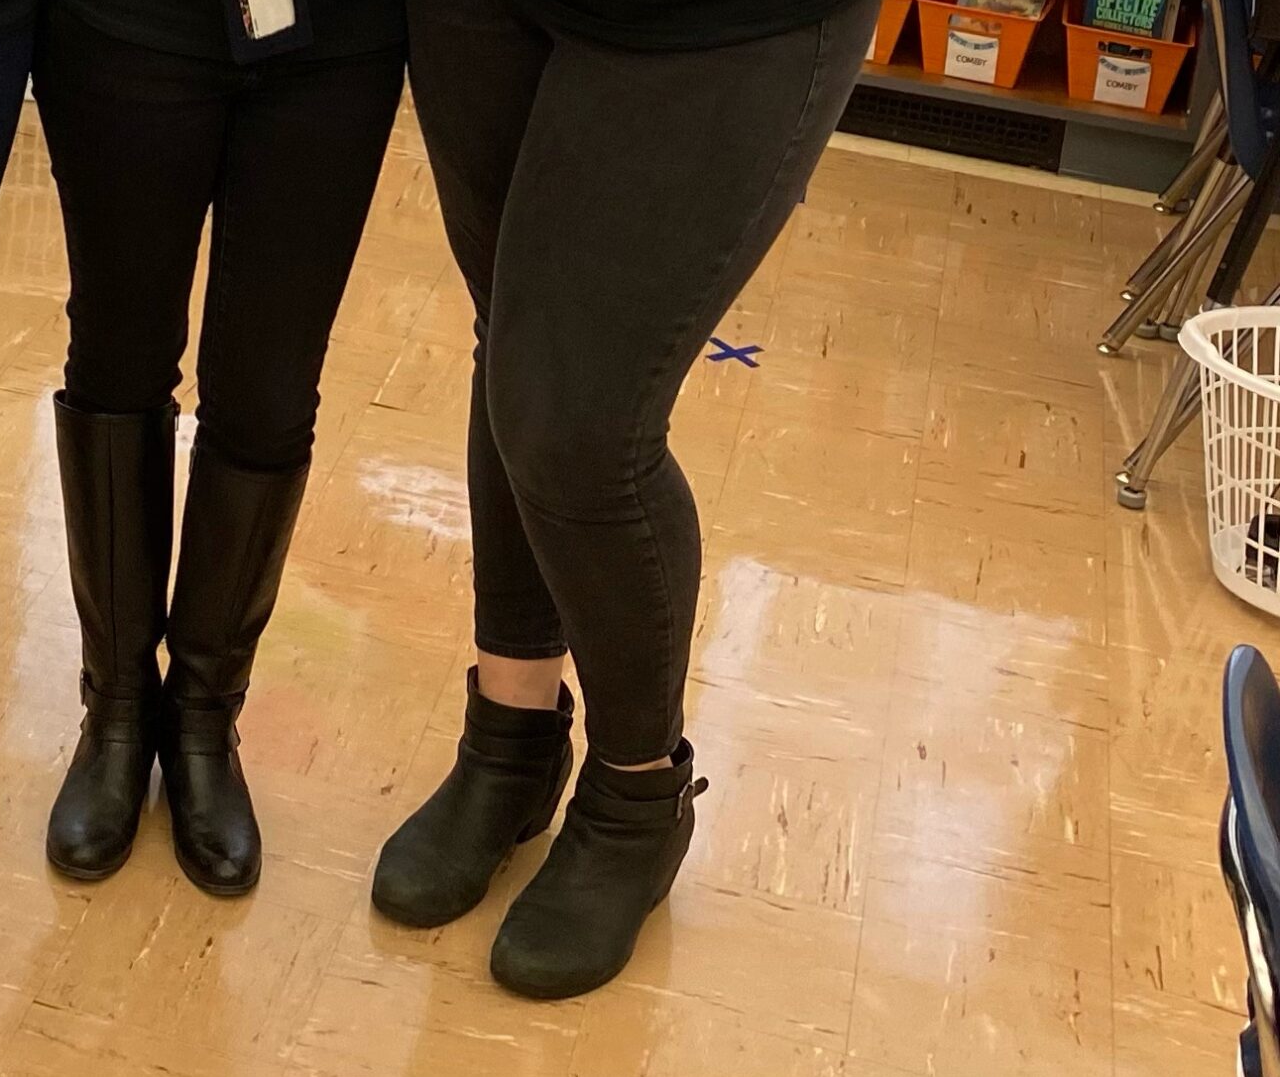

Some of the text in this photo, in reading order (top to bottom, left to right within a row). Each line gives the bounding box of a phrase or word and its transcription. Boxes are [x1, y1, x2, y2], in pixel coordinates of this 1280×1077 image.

[1096, 7, 1156, 30] COLLECTORS
[956, 54, 987, 66] COMEDY
[1106, 79, 1138, 92] COMEDY
